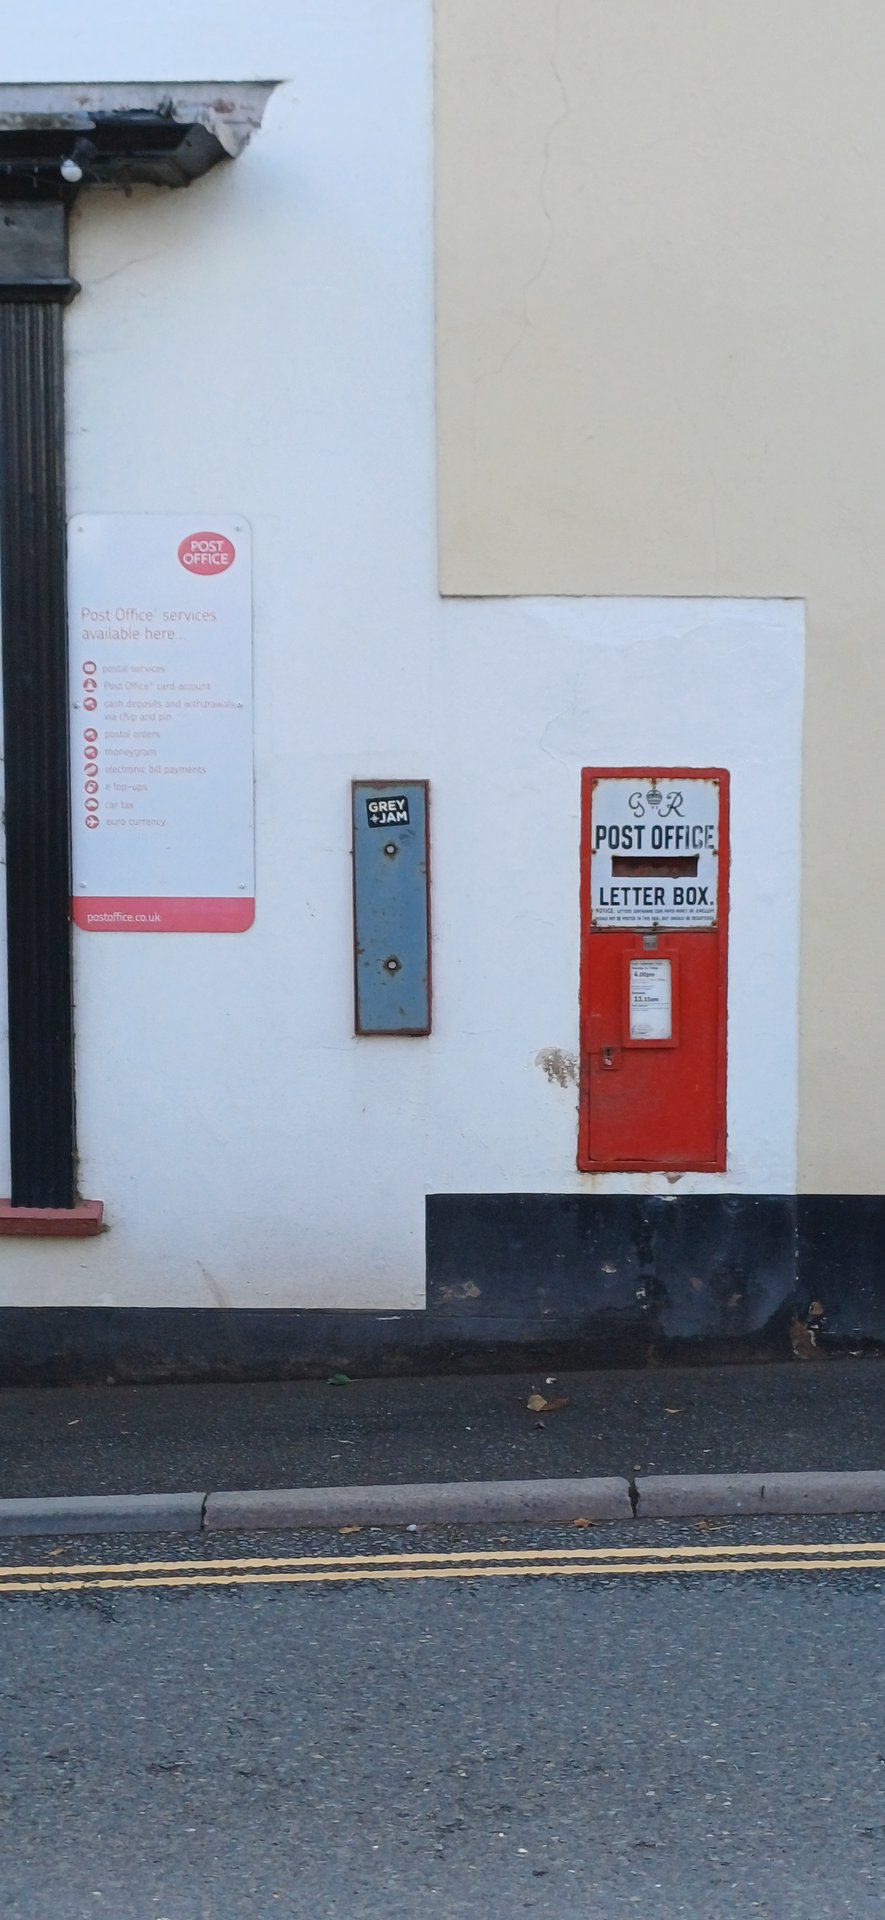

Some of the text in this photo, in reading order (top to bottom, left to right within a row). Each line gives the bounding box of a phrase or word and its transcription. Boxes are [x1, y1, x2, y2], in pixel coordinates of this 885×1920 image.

[190, 540, 224, 552] POST
[183, 552, 229, 565] OFFICE
[81, 607, 111, 622] Post
[163, 610, 217, 622] services
[81, 626, 140, 640] available
[102, 664, 166, 674] postal services
[104, 681, 123, 691] Post
[156, 681, 176, 691] card
[178, 682, 211, 691] account
[104, 699, 124, 709] cash
[126, 699, 162, 711] deposits
[165, 699, 182, 709] and
[104, 712, 173, 723] via chip and pin
[104, 730, 160, 740] postal orders
[104, 748, 157, 758] moneygram
[105, 765, 207, 777] electronic bill payments
[113, 782, 148, 793] top-ups
[105, 800, 135, 809] car tax
[368, 798, 406, 813] GREY
[628, 791, 686, 818] G R
[106, 818, 167, 828] euro currency
[595, 824, 715, 850] POST OFFICE
[599, 886, 715, 907] LETTER BOX.
[87, 911, 161, 923] postoffice.co.uk
